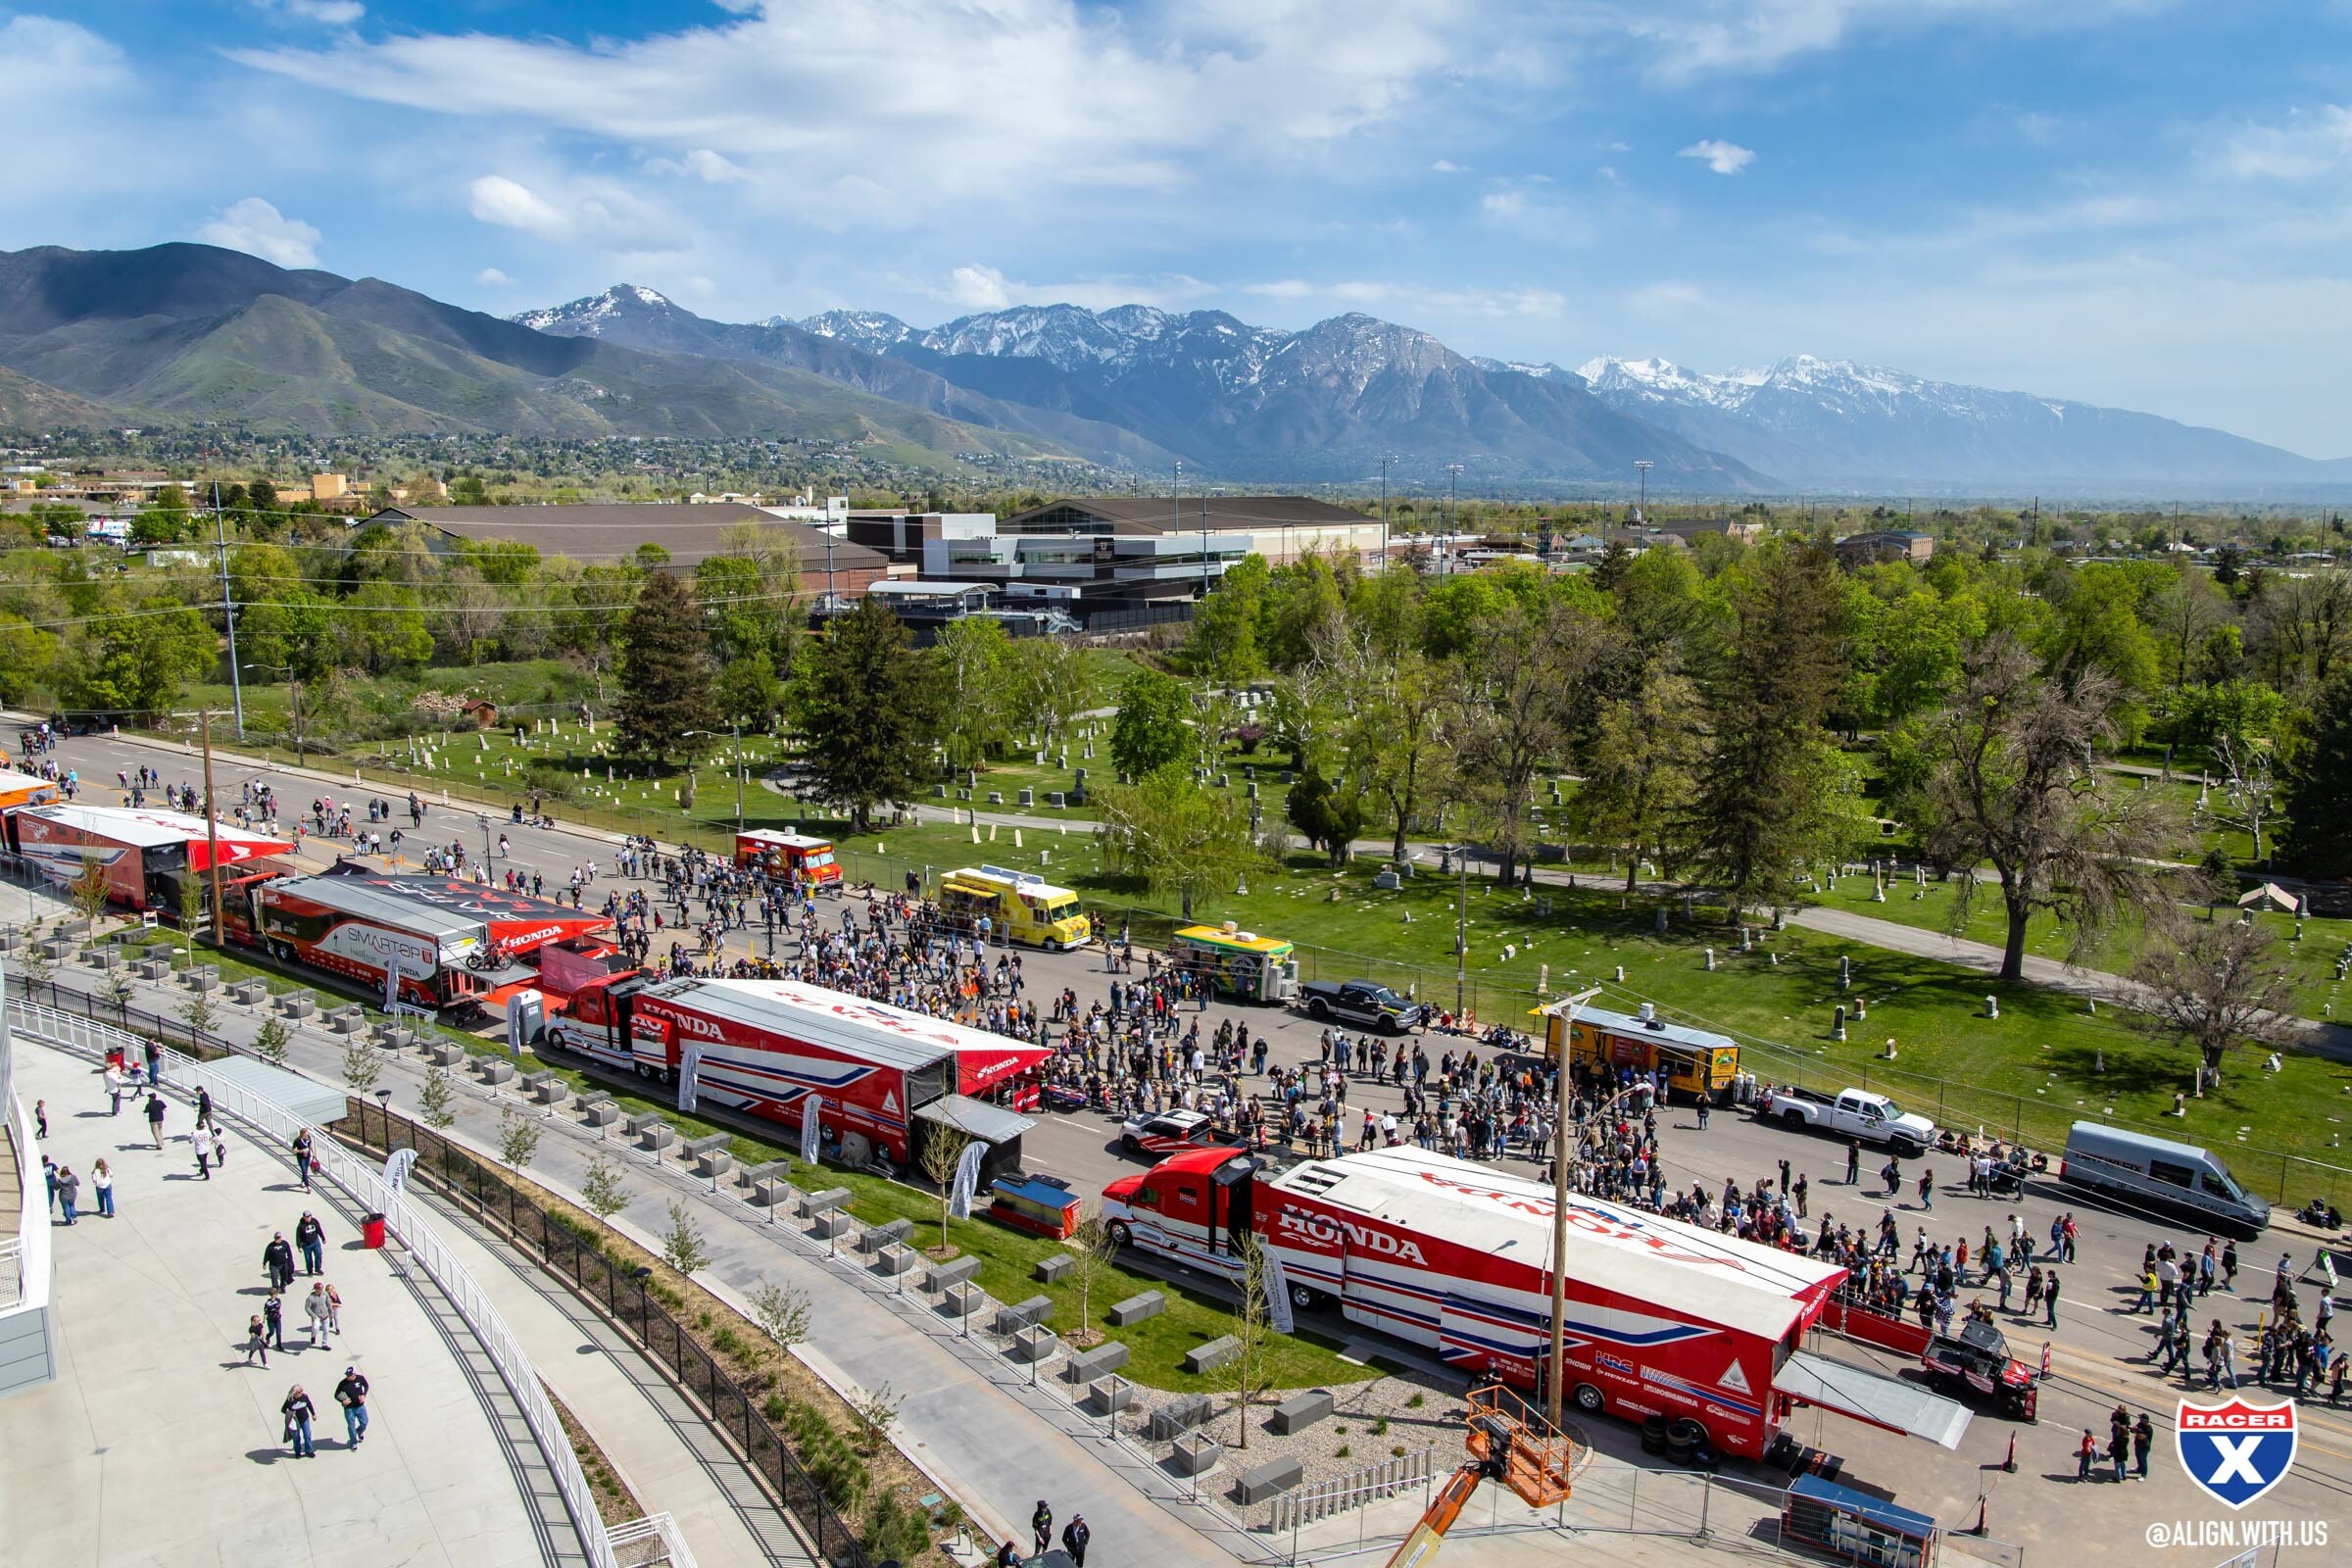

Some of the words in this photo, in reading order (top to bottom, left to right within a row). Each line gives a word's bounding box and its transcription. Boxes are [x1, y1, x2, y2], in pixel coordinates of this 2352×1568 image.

[510, 925, 564, 947] HONDA
[398, 965, 421, 978] ONDA
[985, 1056, 1019, 1075] HONDA
[1279, 1203, 1428, 1265] HONDA
[1565, 1357, 1592, 1371] SHOWA
[1595, 1349, 1633, 1374] HRC
[1603, 1371, 1640, 1386] DUNLOP
